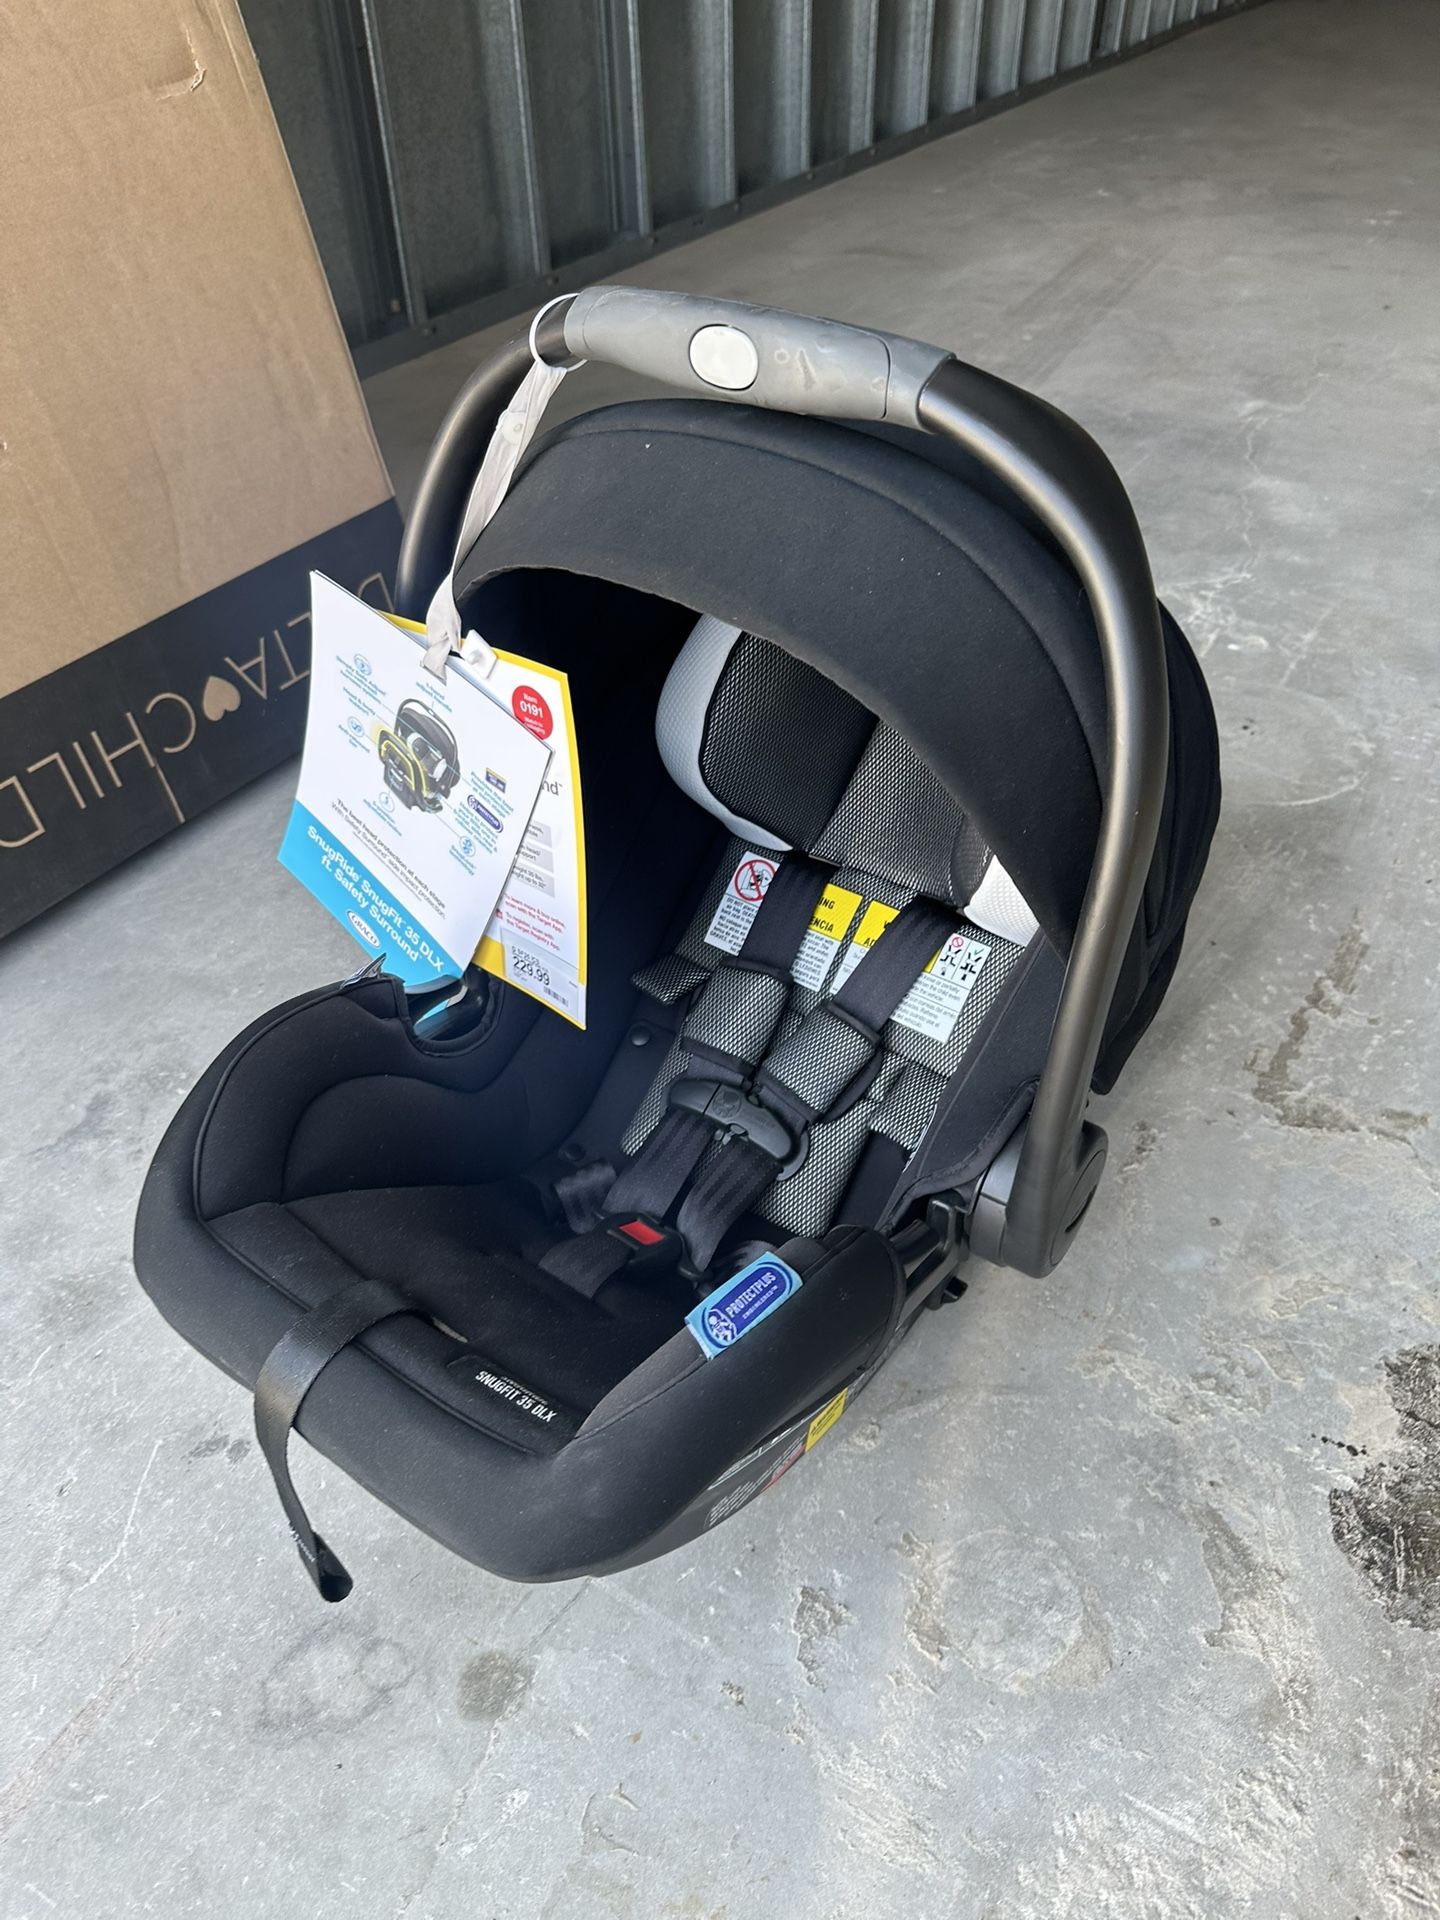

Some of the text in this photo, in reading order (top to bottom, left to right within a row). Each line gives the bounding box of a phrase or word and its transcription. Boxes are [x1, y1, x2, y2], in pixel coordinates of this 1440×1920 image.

[520, 700, 543, 718] 0191
[321, 855, 332, 872] ft.
[334, 868, 369, 908] Safety
[369, 905, 421, 962] Surround
[350, 914, 378, 943] GRACO
[360, 880, 404, 927] SnugFit
[405, 926, 420, 945] 35
[419, 942, 444, 972] DLX
[513, 956, 550, 986] 229.99
[725, 1272, 776, 1318] PROTECTPLUS
[475, 1371, 521, 1403] SNUGFIT
[516, 1393, 536, 1409] 35
[531, 1404, 557, 1422] DLX
